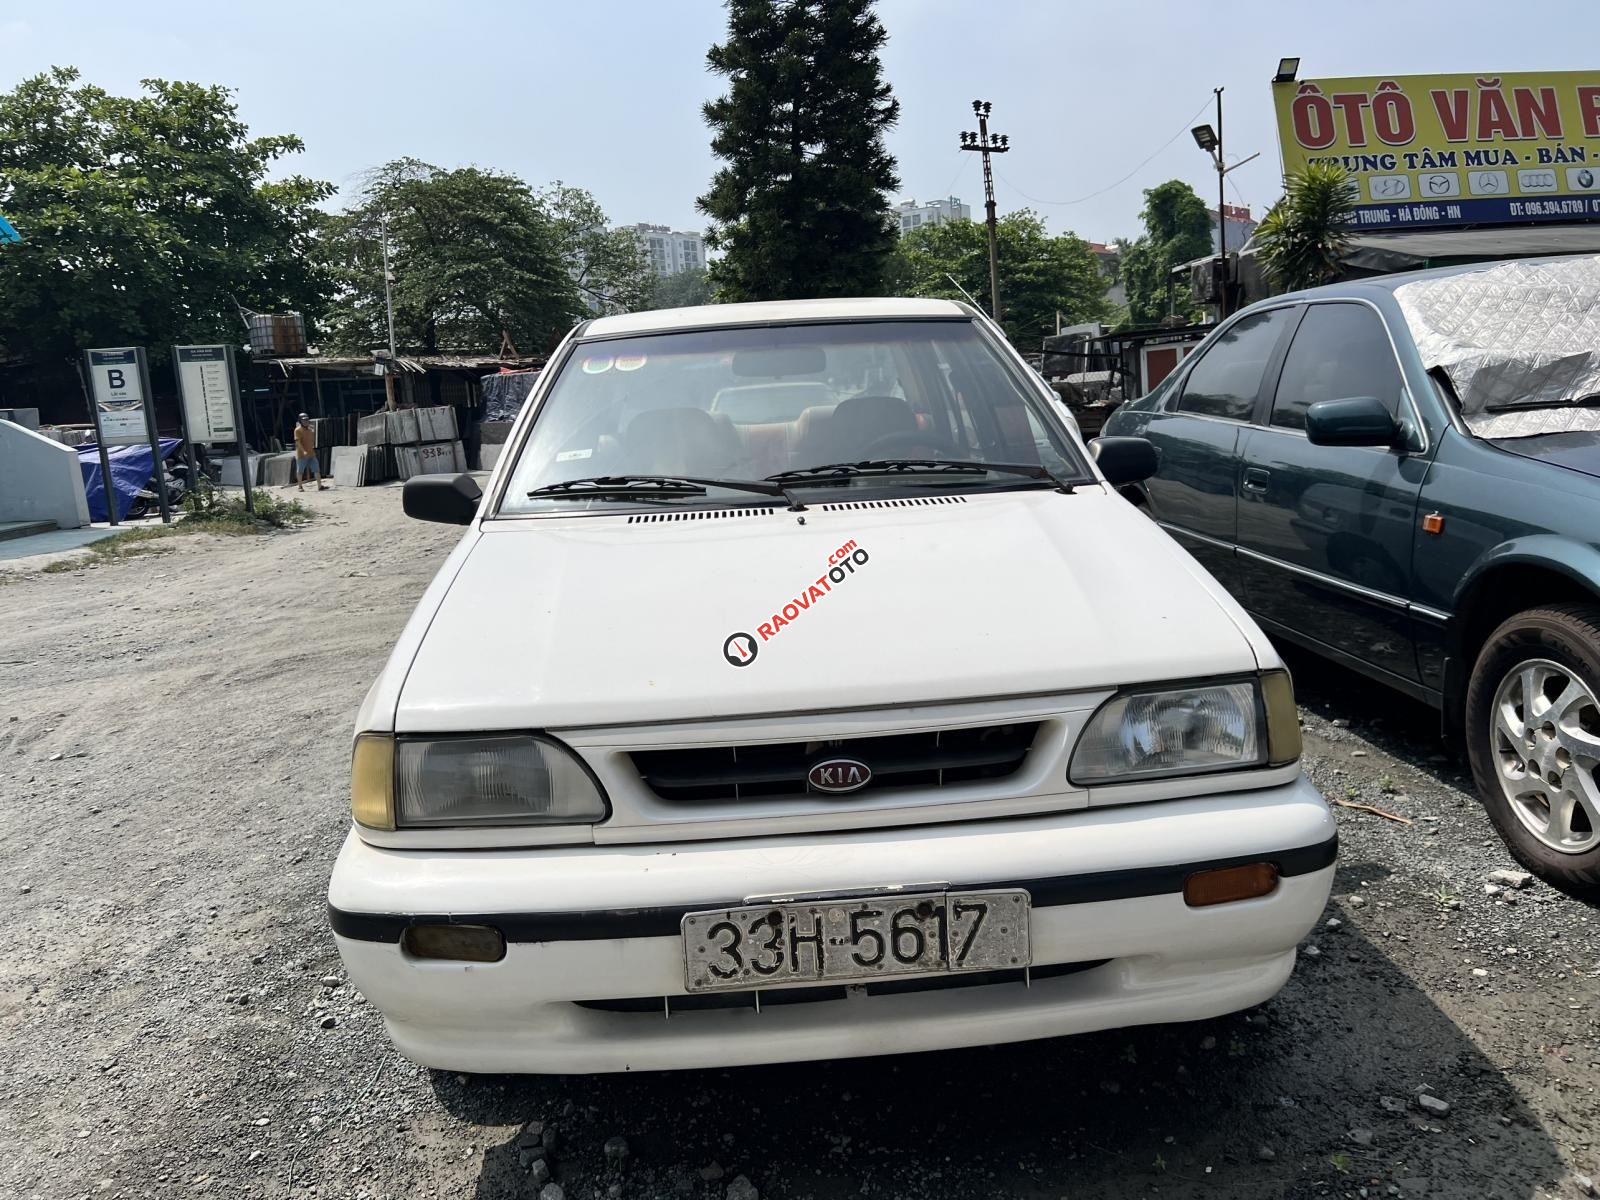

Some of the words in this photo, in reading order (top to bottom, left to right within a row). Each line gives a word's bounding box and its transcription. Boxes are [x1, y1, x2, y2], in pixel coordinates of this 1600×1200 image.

[1292, 81, 1415, 148] ÔTÔ
[1430, 77, 1564, 141] VĂN
[1403, 148, 1457, 169] TÂM
[1463, 150, 1518, 167] MUA
[1536, 143, 1586, 164] BÁN
[1358, 209, 1391, 223] TRUNG
[1398, 205, 1412, 221] HÀ
[1447, 205, 1461, 218] HN
[1525, 200, 1583, 215] 096.394.6789
[107, 369, 126, 389] B
[820, 766, 862, 784] KIA
[706, 902, 989, 980] 33H-5617
